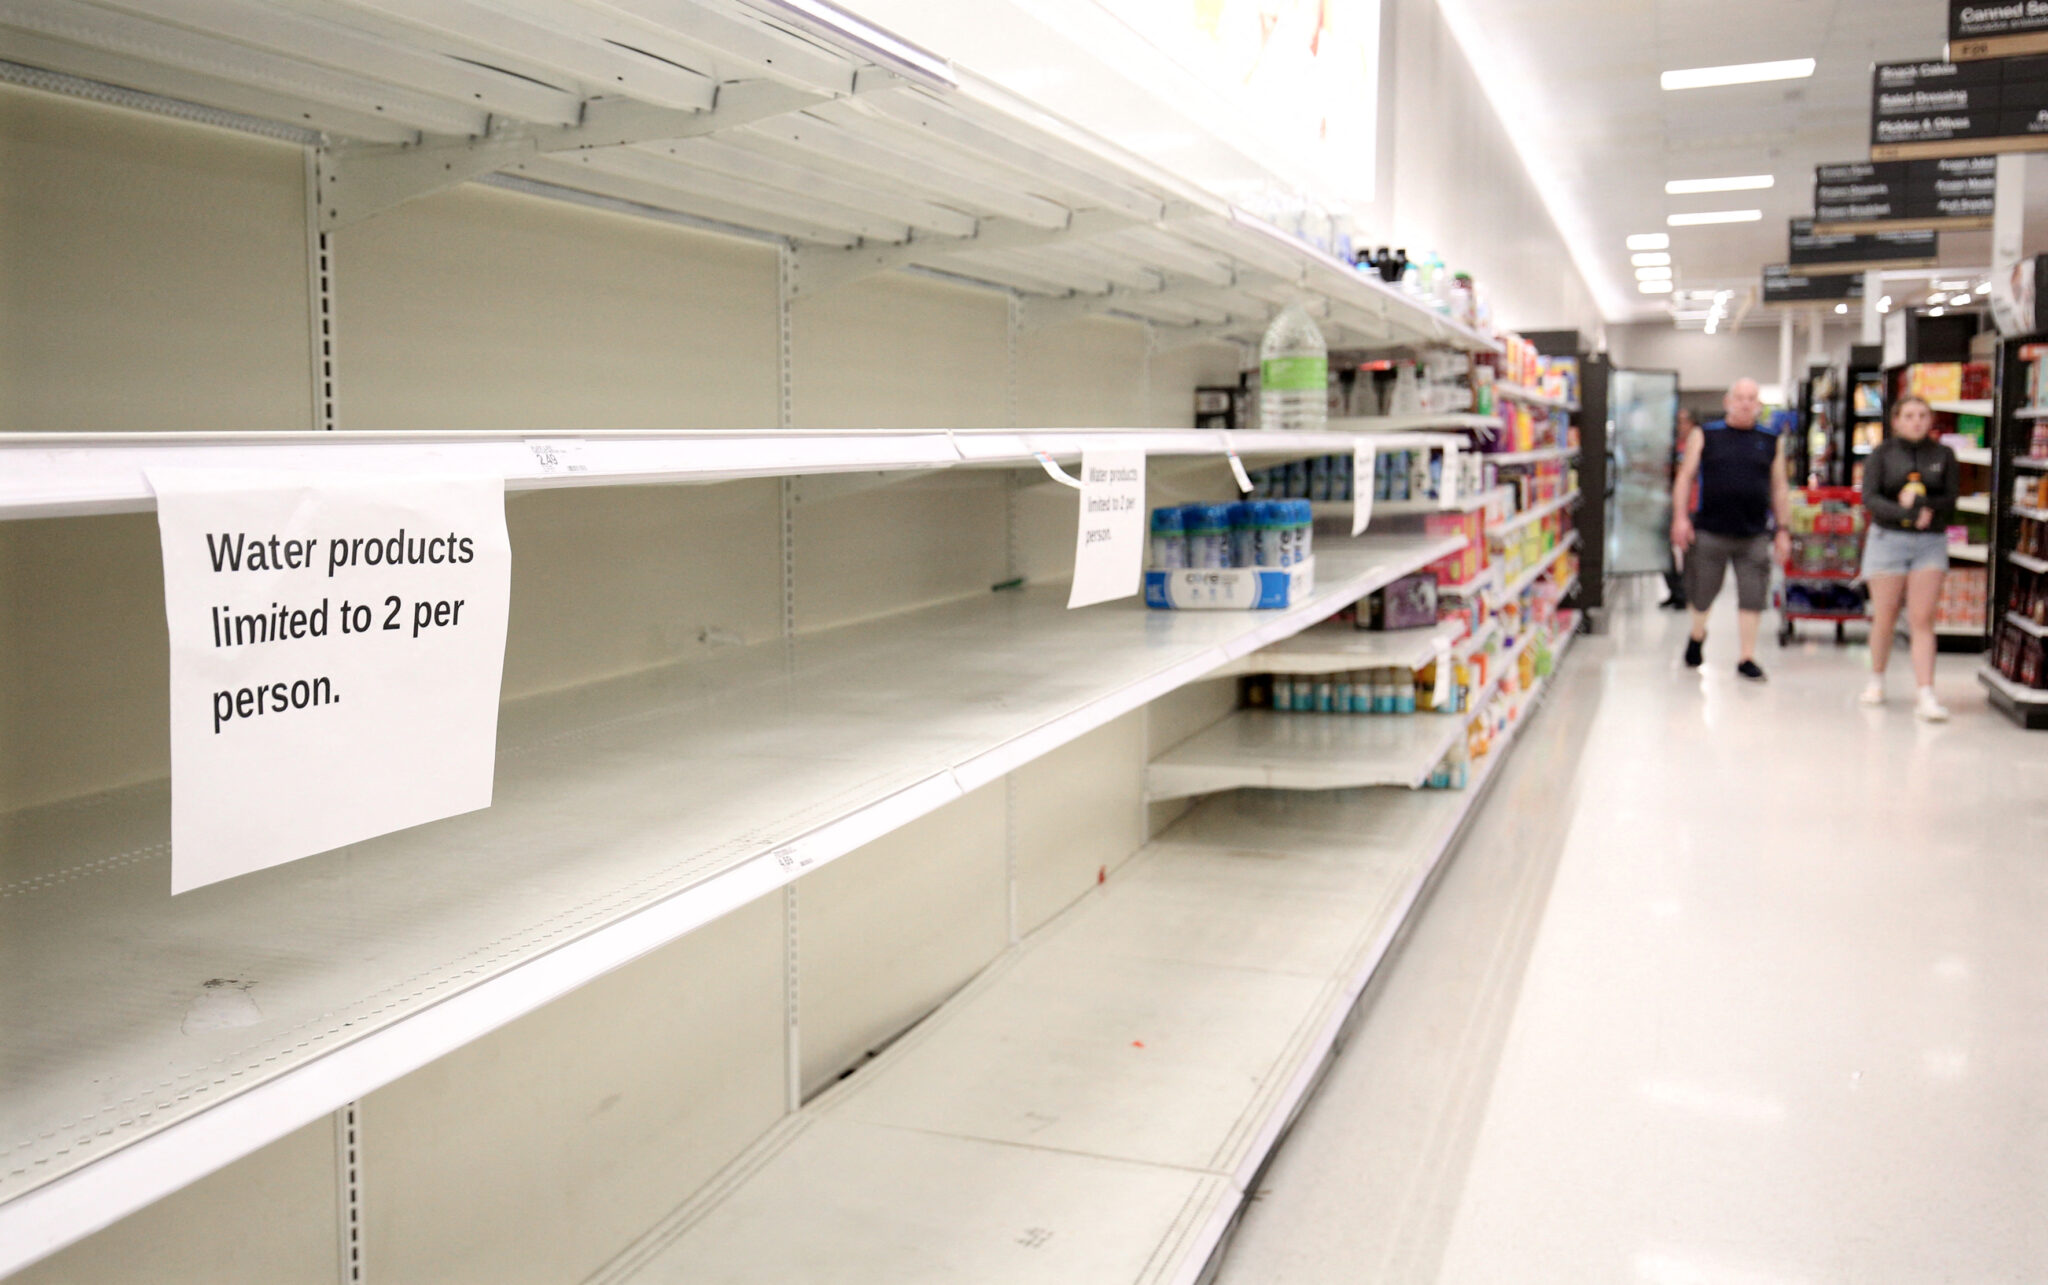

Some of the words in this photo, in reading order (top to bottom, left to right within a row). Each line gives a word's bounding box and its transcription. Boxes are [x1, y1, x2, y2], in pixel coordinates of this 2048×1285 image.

[1960, 3, 2024, 24] Canned
[536, 454, 558, 466] 2.49
[1089, 467, 1108, 482] Water
[1110, 467, 1138, 485] products
[1088, 496, 1110, 512] limited
[1112, 497, 1119, 511] to
[1120, 495, 1125, 510] 2
[1126, 497, 1136, 514] per
[1085, 528, 1112, 548] person.
[206, 532, 317, 573] Water
[328, 528, 475, 578] products
[211, 598, 329, 649] limited
[340, 600, 372, 635] to
[382, 595, 402, 631] 2
[412, 597, 465, 638] per
[212, 675, 341, 735] person.
